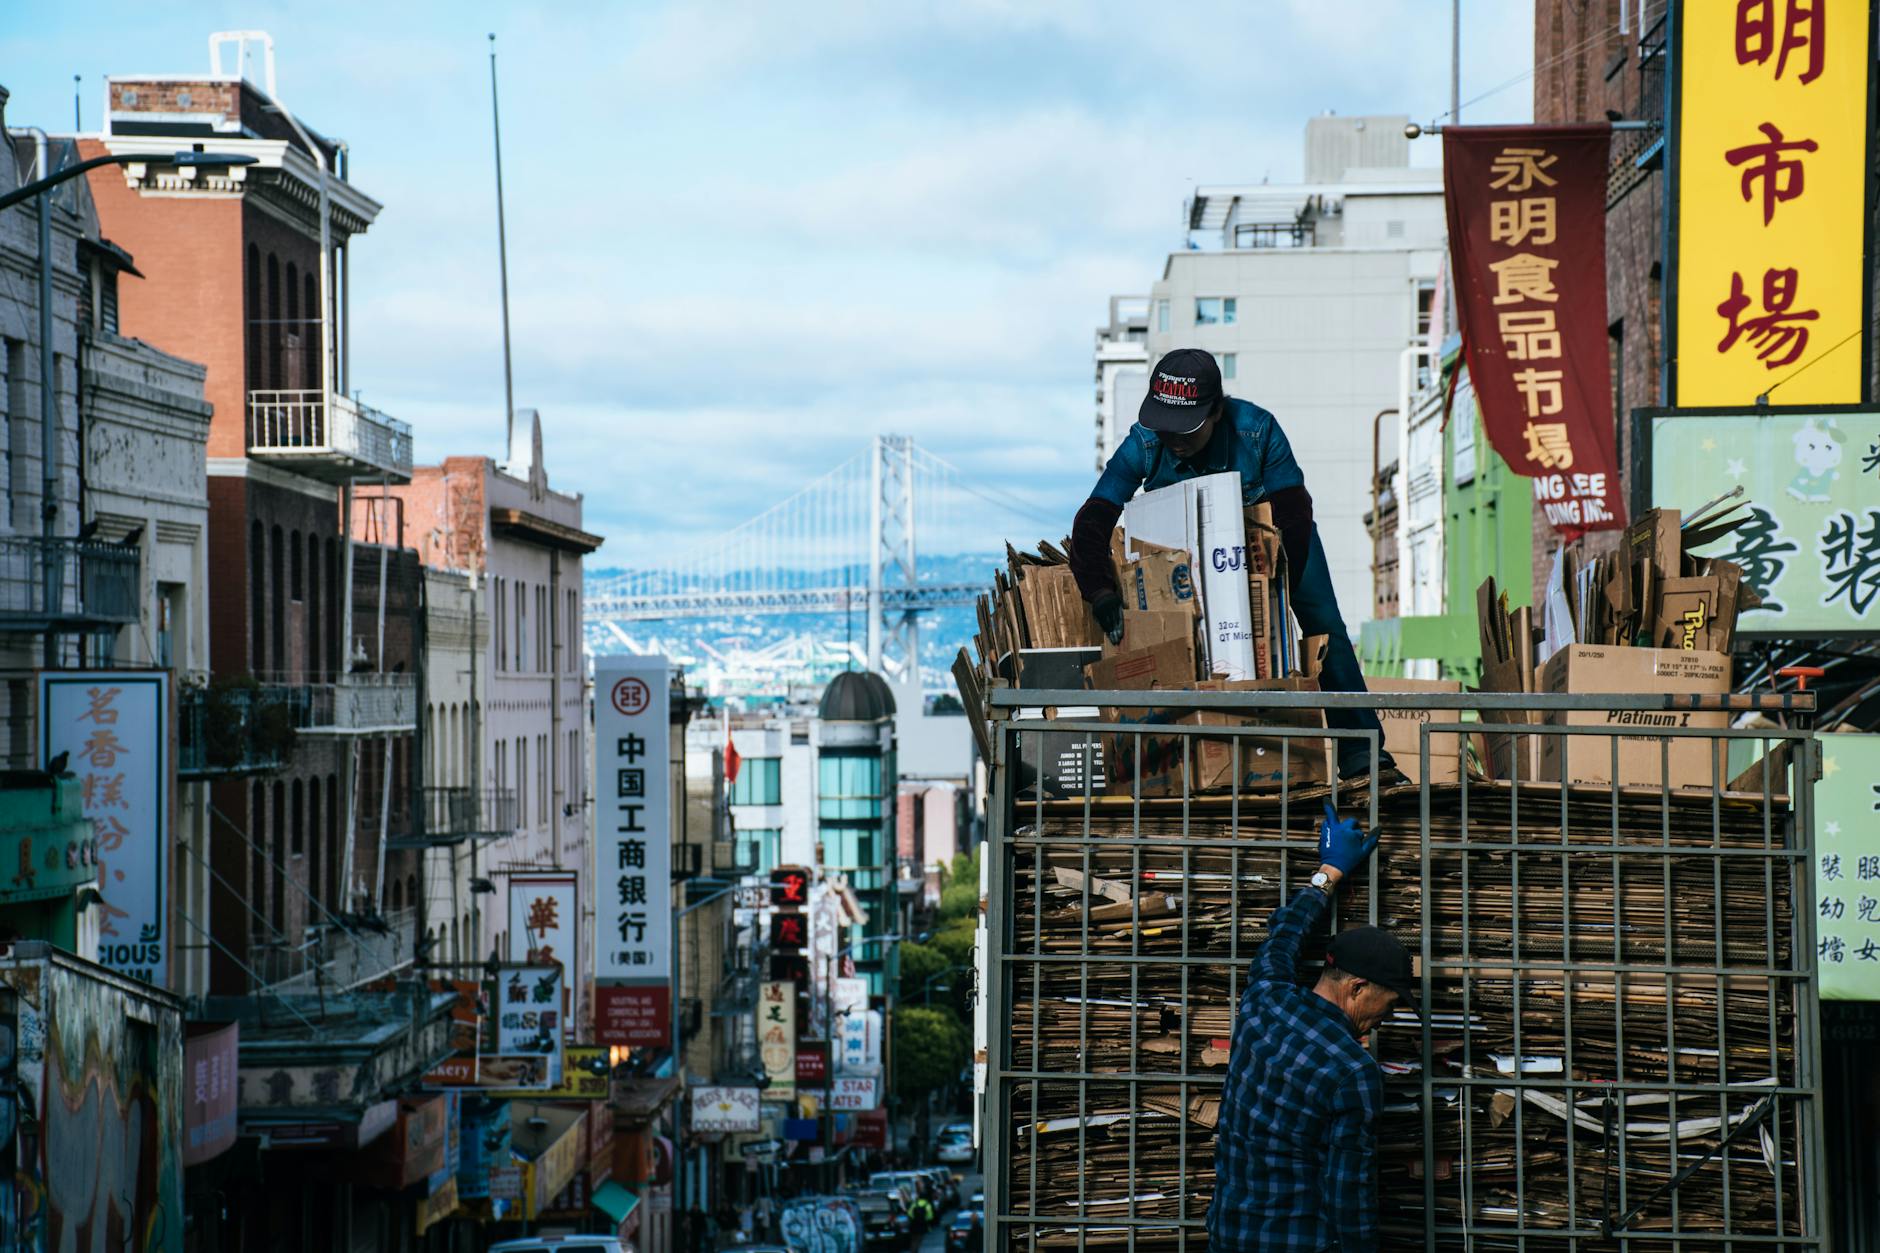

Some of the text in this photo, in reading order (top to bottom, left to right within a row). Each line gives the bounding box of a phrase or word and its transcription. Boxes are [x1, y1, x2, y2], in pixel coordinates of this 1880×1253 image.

[1153, 378, 1198, 398] ALCATRAZ
[1606, 709, 1677, 727] Platinum
[616, 733, 648, 943] 中国工商银行
[843, 1080, 873, 1093] STAR
